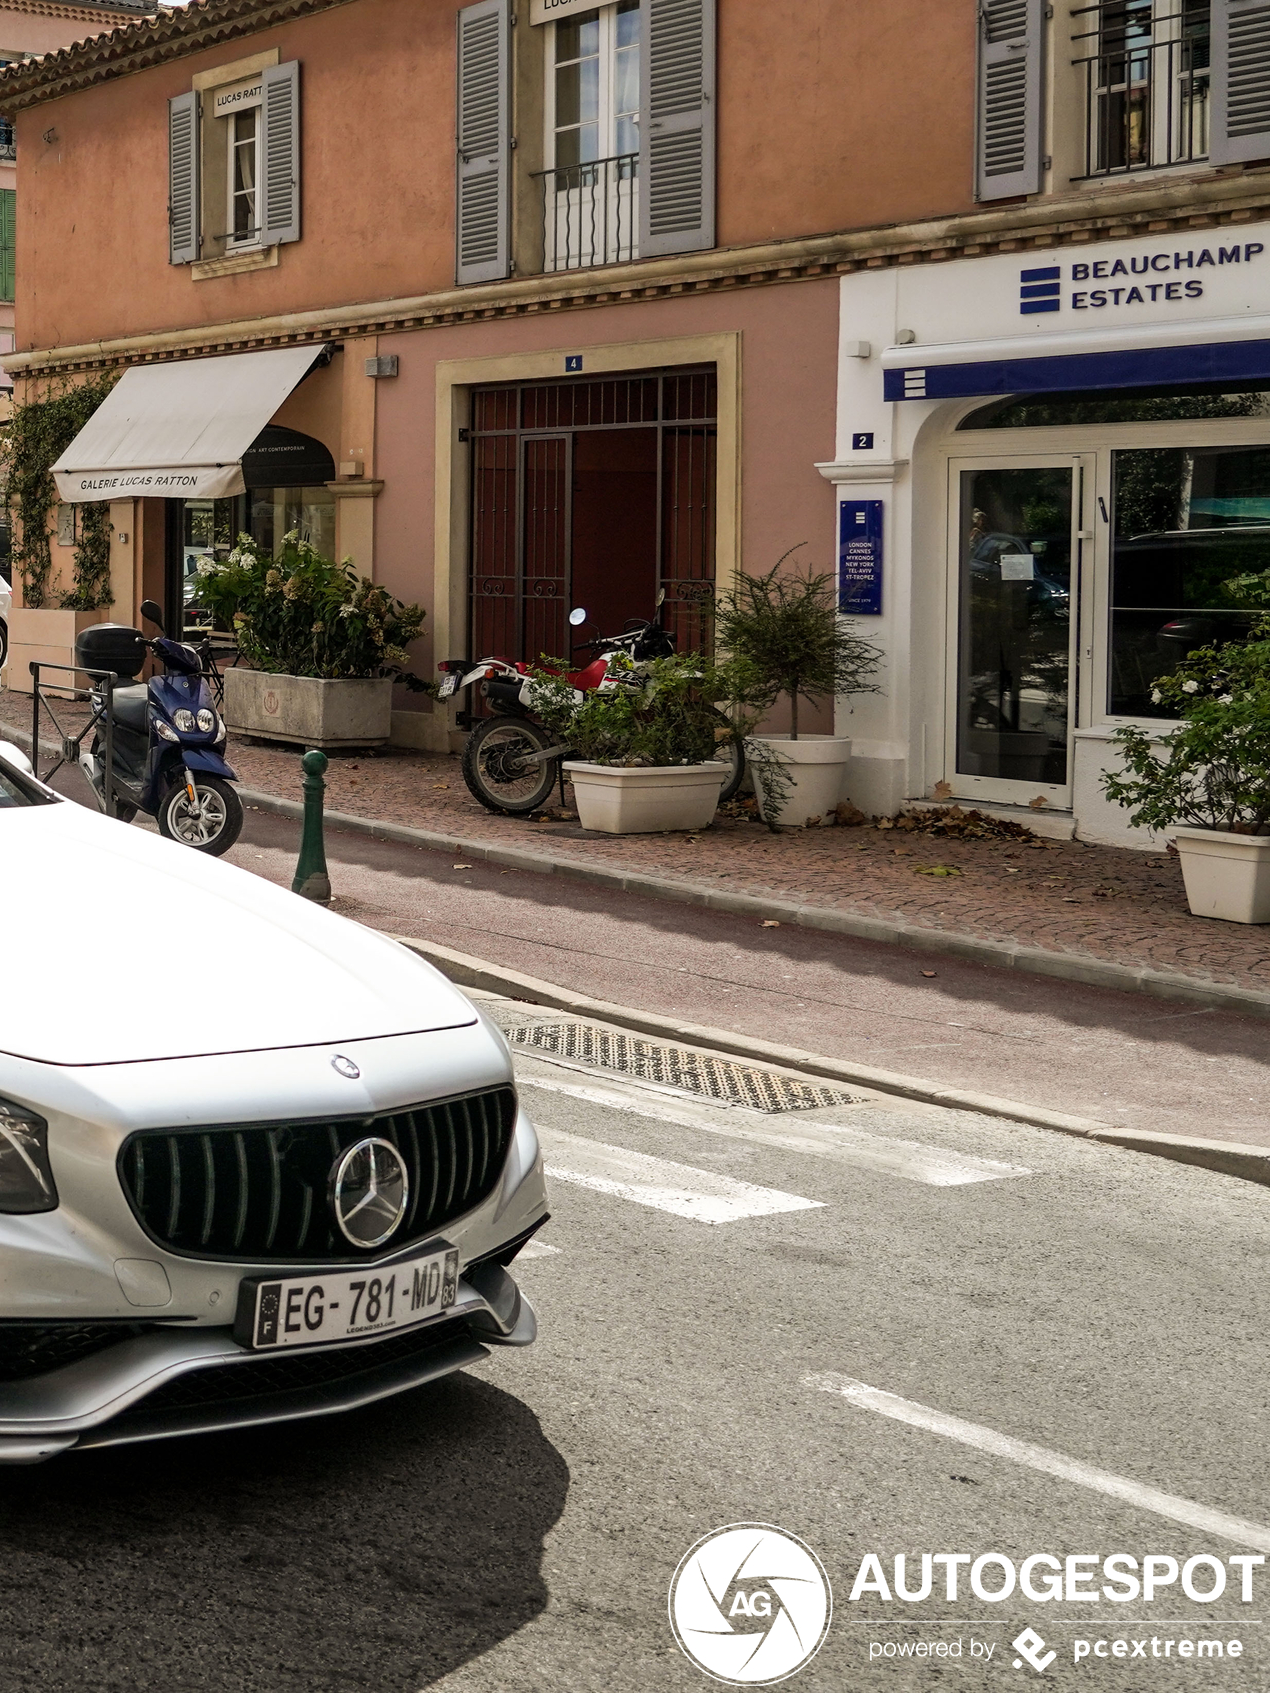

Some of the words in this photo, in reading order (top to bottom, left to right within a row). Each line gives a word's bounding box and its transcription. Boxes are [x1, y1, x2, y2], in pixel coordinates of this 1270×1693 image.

[217, 92, 241, 106] LUCAS
[1071, 242, 1264, 282] BEAUCHAMP
[1071, 279, 1204, 310] ESTATES
[570, 358, 577, 368] 4
[858, 435, 867, 447] 2
[80, 478, 119, 490] GALERIE
[120, 476, 153, 487] LUCAS
[154, 475, 198, 486] RATTON
[442, 1284, 455, 1305] 83
[263, 1321, 272, 1335] F
